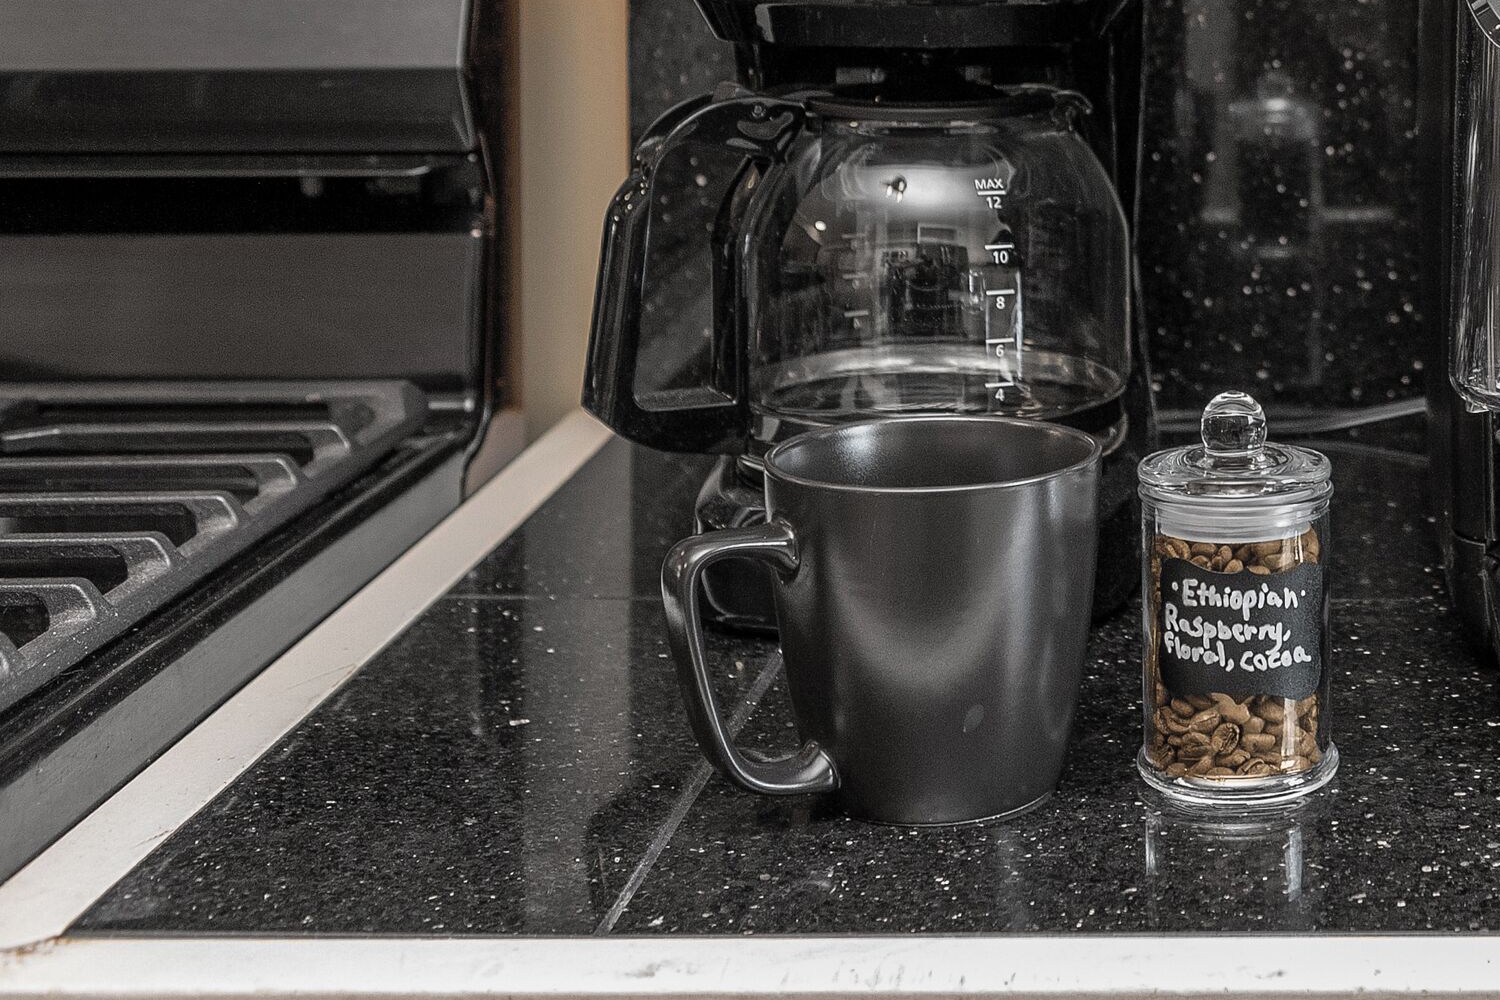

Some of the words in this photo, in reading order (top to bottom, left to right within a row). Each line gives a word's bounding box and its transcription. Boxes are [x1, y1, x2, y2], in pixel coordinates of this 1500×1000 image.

[974, 178, 1004, 190] MAX
[986, 196, 1001, 209] 12
[993, 250, 1009, 264] 10
[995, 296, 1006, 310] 8
[995, 344, 1005, 357] 6
[994, 388, 1005, 402] 4
[1165, 602, 1291, 652] Raspberry,
